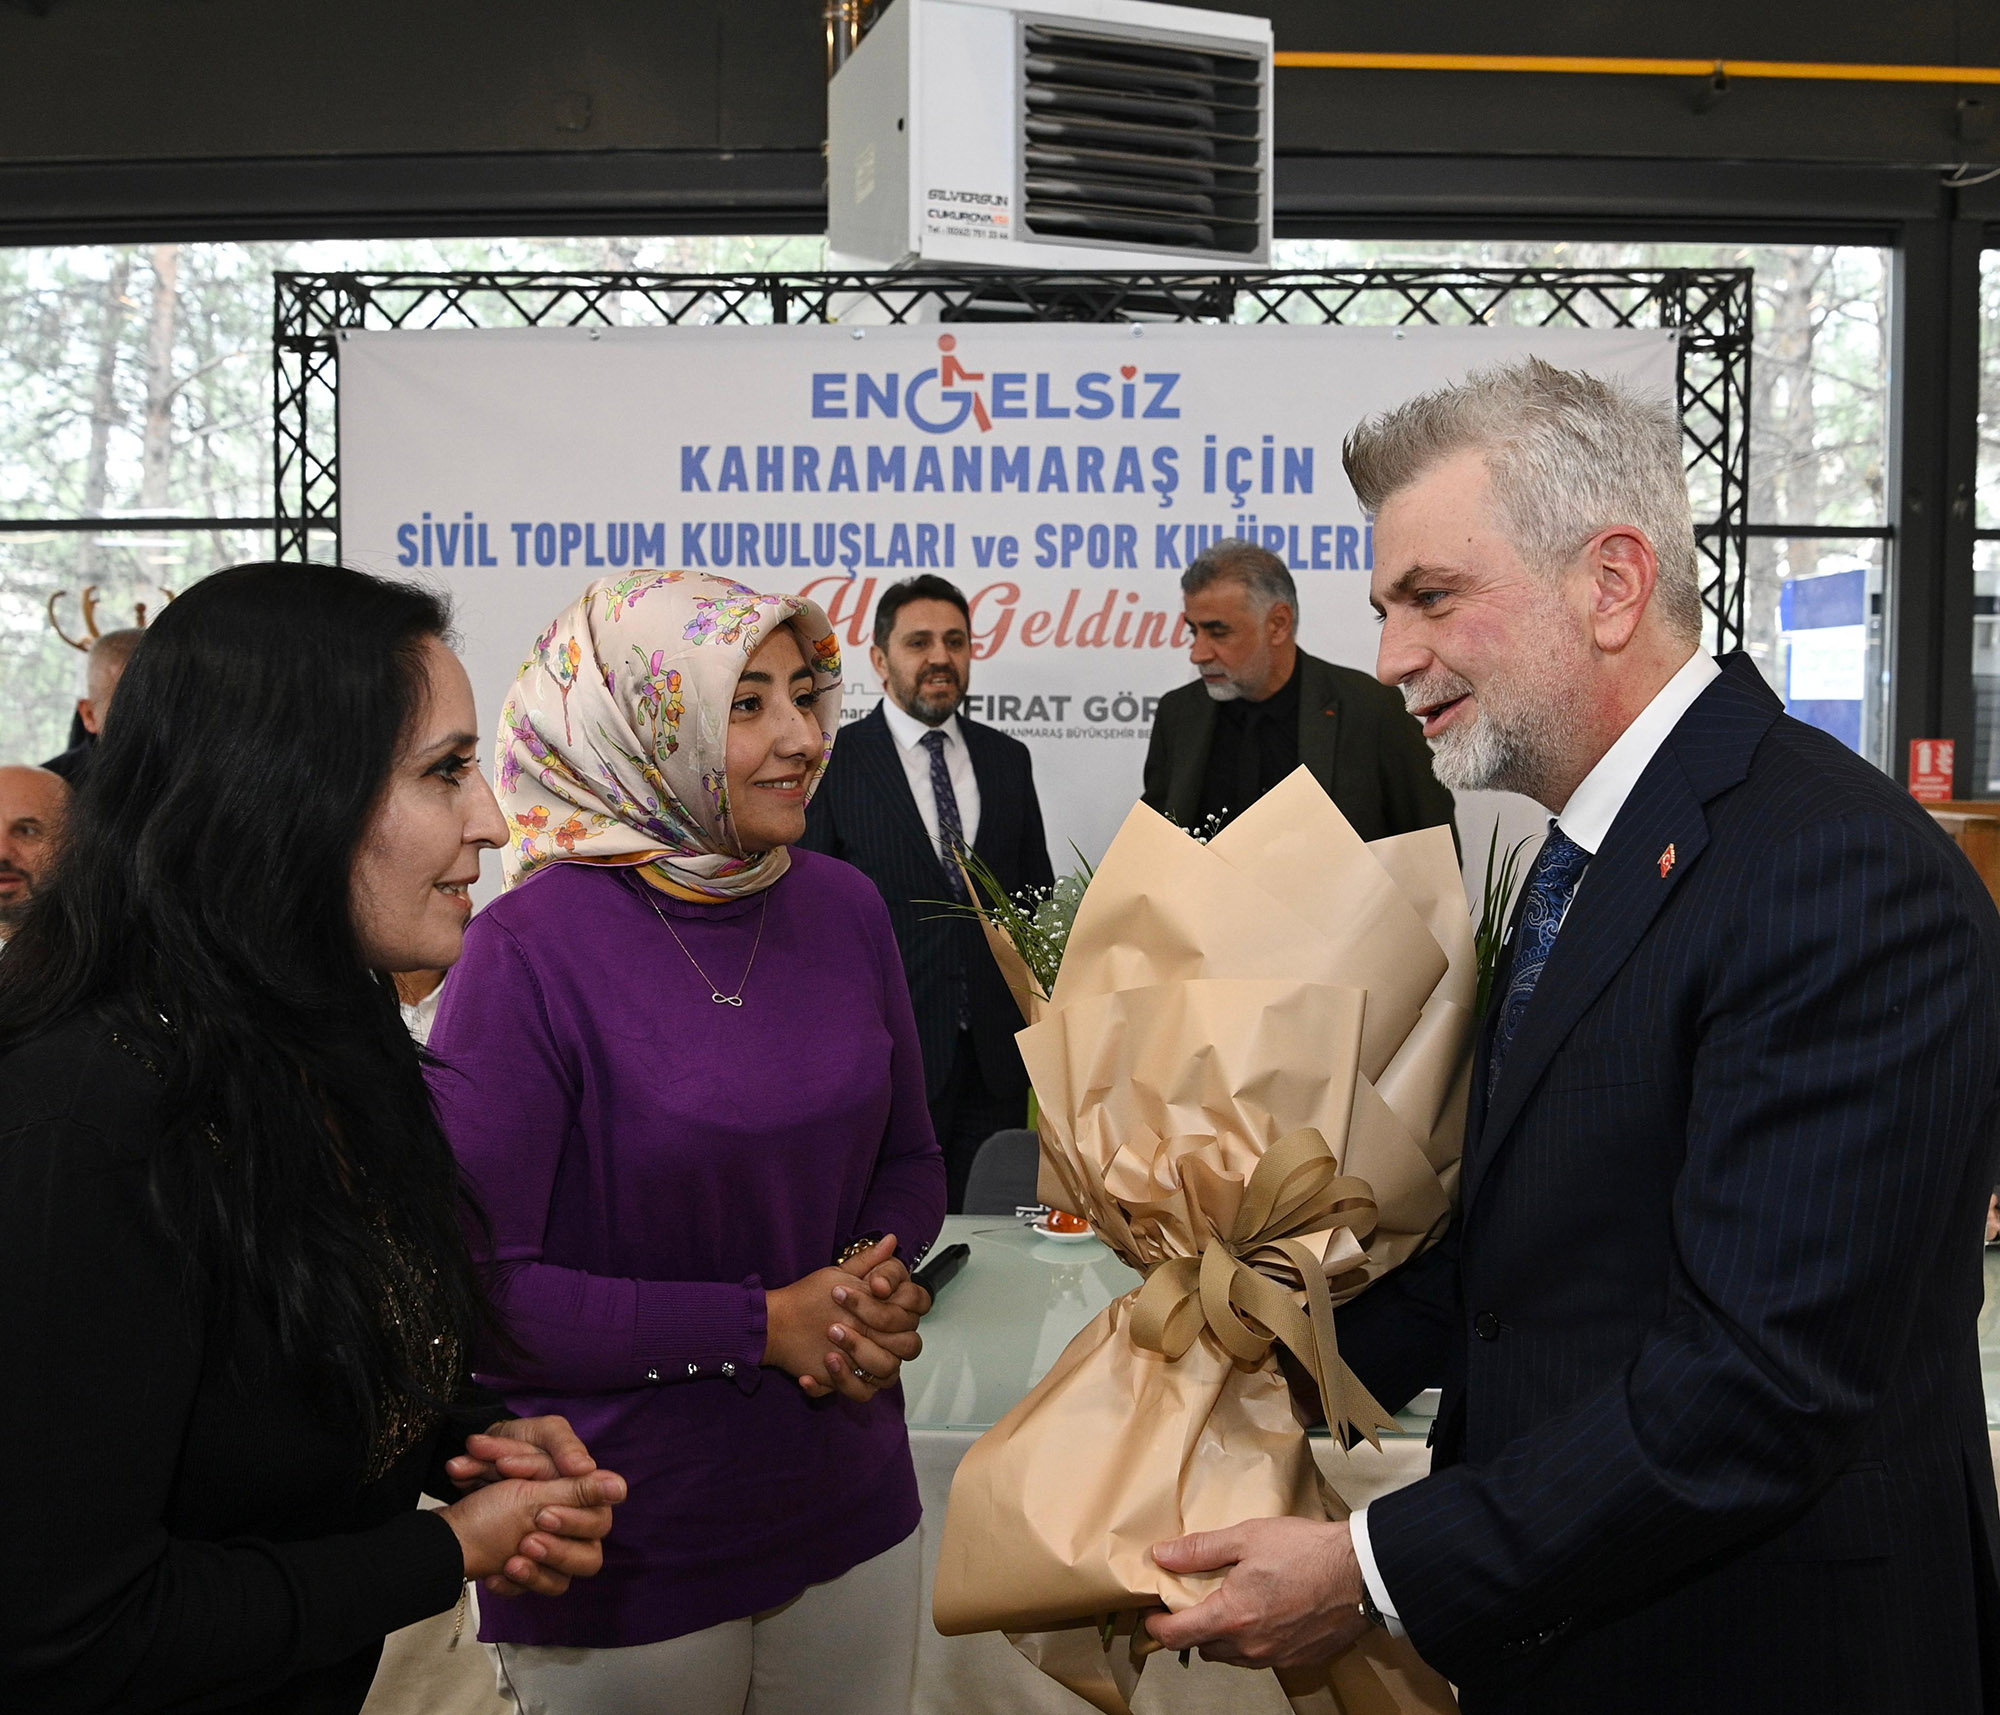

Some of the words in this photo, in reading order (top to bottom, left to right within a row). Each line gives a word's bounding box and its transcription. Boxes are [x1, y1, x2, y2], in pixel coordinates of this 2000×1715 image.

[927, 188, 1009, 206] SILVERSUN
[681, 445, 1180, 508] KAHRAMANMARAŞ
[1203, 434, 1314, 509] İÇİN
[397, 511, 498, 567] SİVİL
[511, 522, 665, 567] TOPLUM
[682, 522, 956, 579] KURULUŞLARI
[971, 535, 1019, 568] ve
[1035, 523, 1138, 569] SPOR
[964, 695, 1072, 722] FIRAT
[1083, 691, 1159, 723] GÖR
[1066, 726, 1135, 740] BÜYÜKŞEHİR
